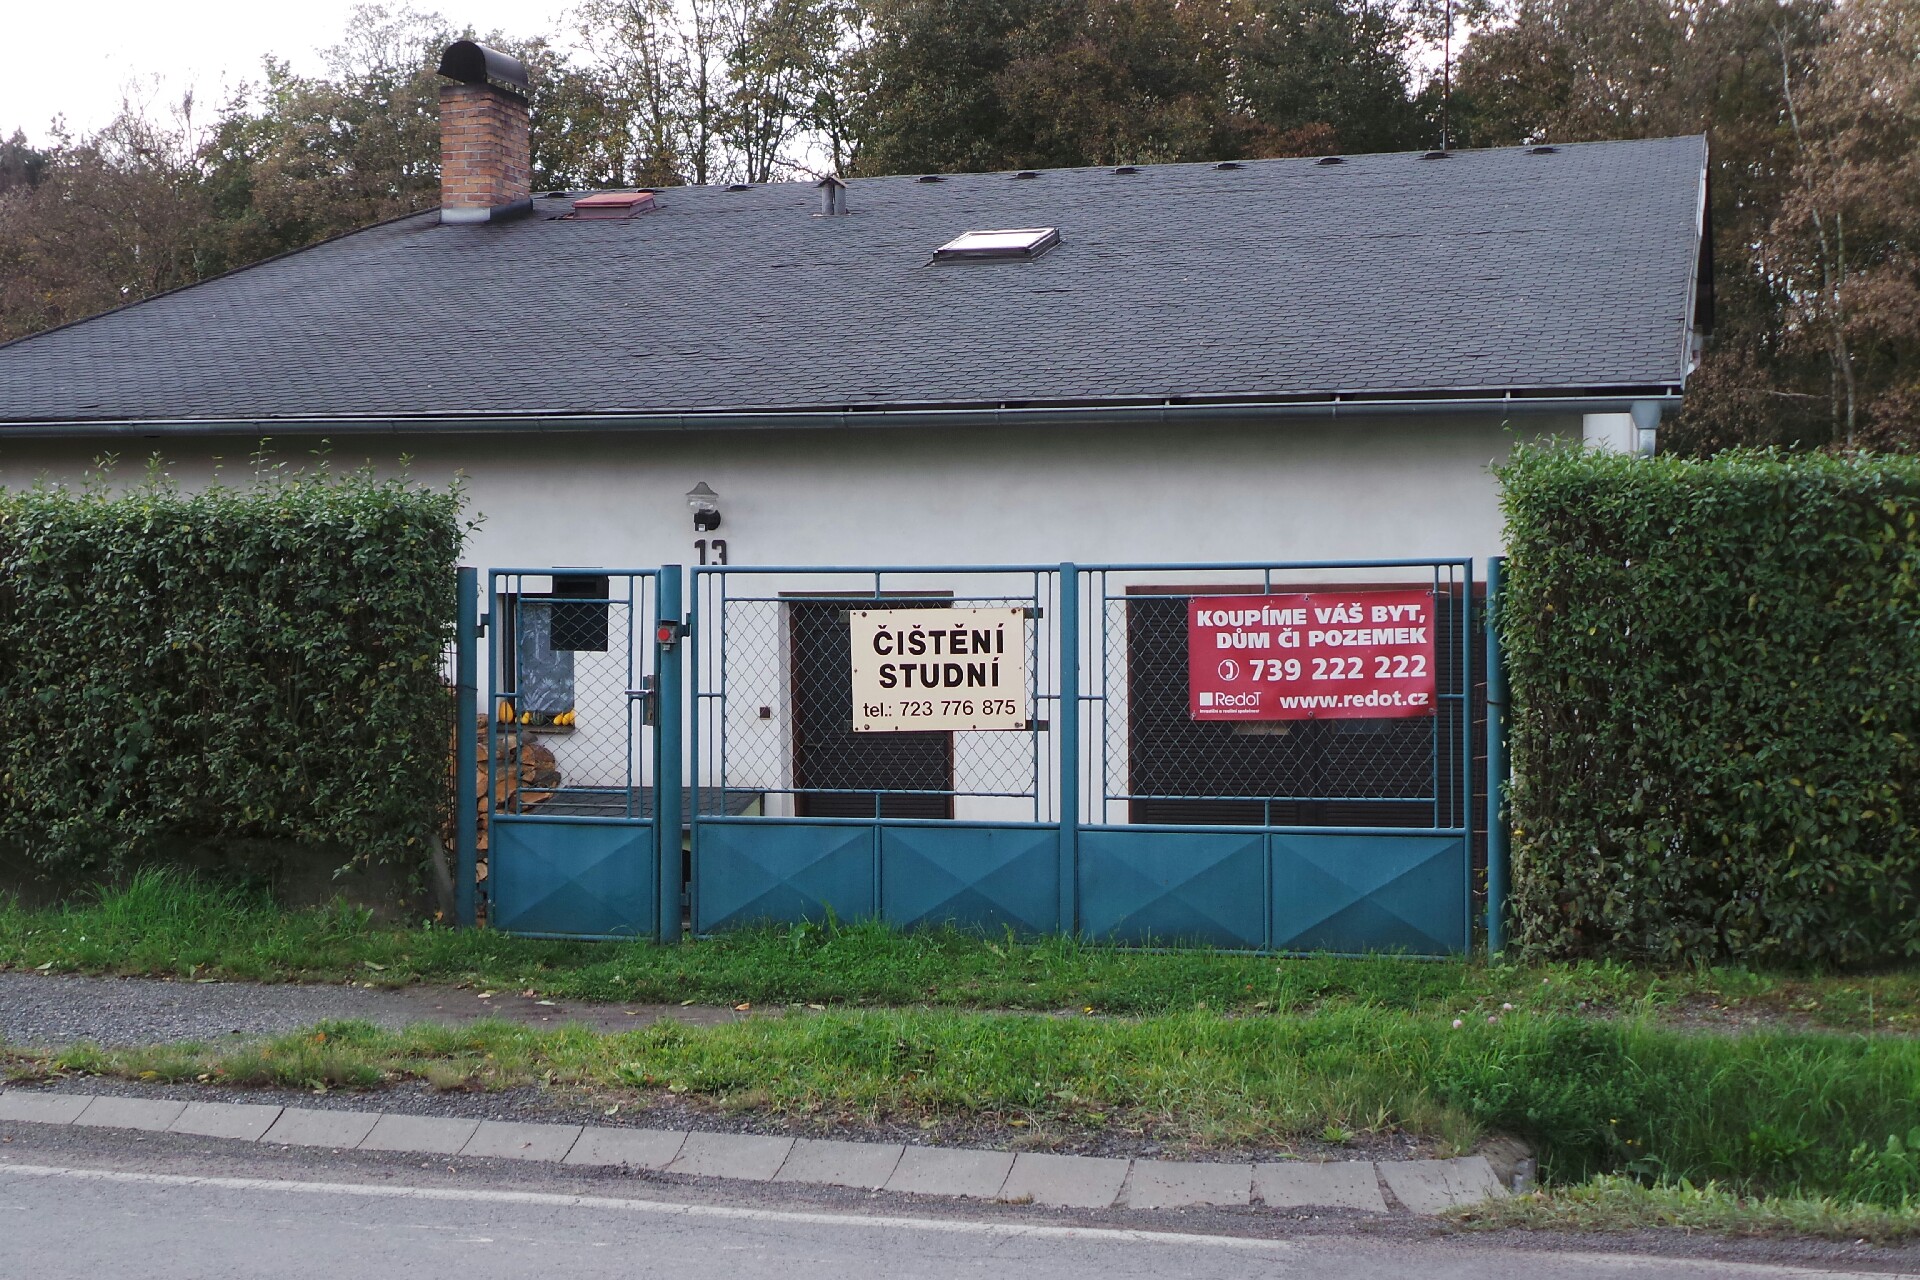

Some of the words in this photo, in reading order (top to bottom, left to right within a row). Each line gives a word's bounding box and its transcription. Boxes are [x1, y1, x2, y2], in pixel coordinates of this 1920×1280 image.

[694, 539, 727, 565] 13
[1197, 606, 1307, 627] KOUPÍME
[1315, 603, 1364, 624] VÁŠ
[1372, 605, 1426, 624] BYT,
[873, 623, 1004, 655] ČIŠTĚNÍ
[1217, 628, 1270, 649] DŮM
[1278, 628, 1300, 648] ČI
[1308, 628, 1427, 647] POZEMEK
[879, 657, 1000, 688] STUDNÍ
[1249, 659, 1301, 681] 739
[1311, 657, 1364, 680] 222
[1374, 655, 1427, 678] 222
[863, 702, 892, 717] tel.:
[899, 701, 933, 716] 723
[941, 700, 974, 715] 776
[982, 699, 1016, 715] 875
[1279, 690, 1429, 708] www.redot.cz
